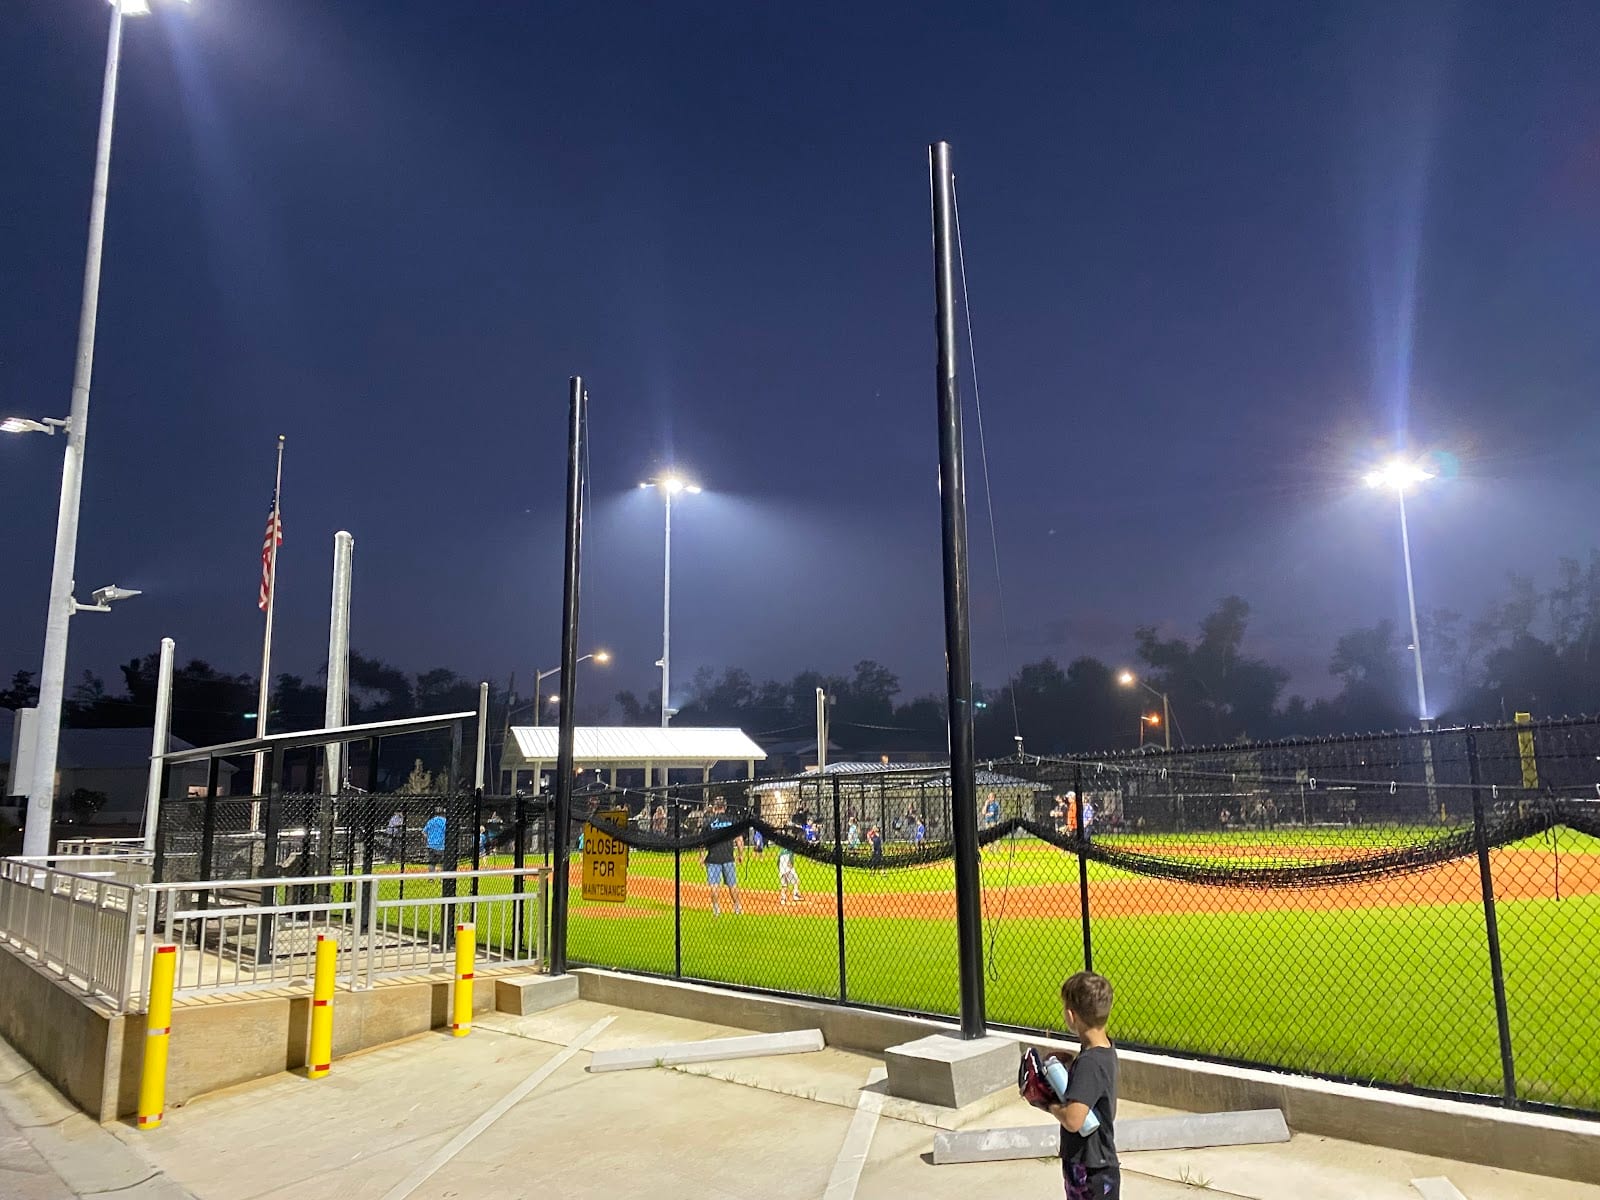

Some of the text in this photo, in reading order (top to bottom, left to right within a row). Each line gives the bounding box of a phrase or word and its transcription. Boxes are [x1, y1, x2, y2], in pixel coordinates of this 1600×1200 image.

[585, 839, 625, 855] CLOSED
[593, 860, 615, 878] FOR
[583, 883, 625, 897] MAINTENANCE
